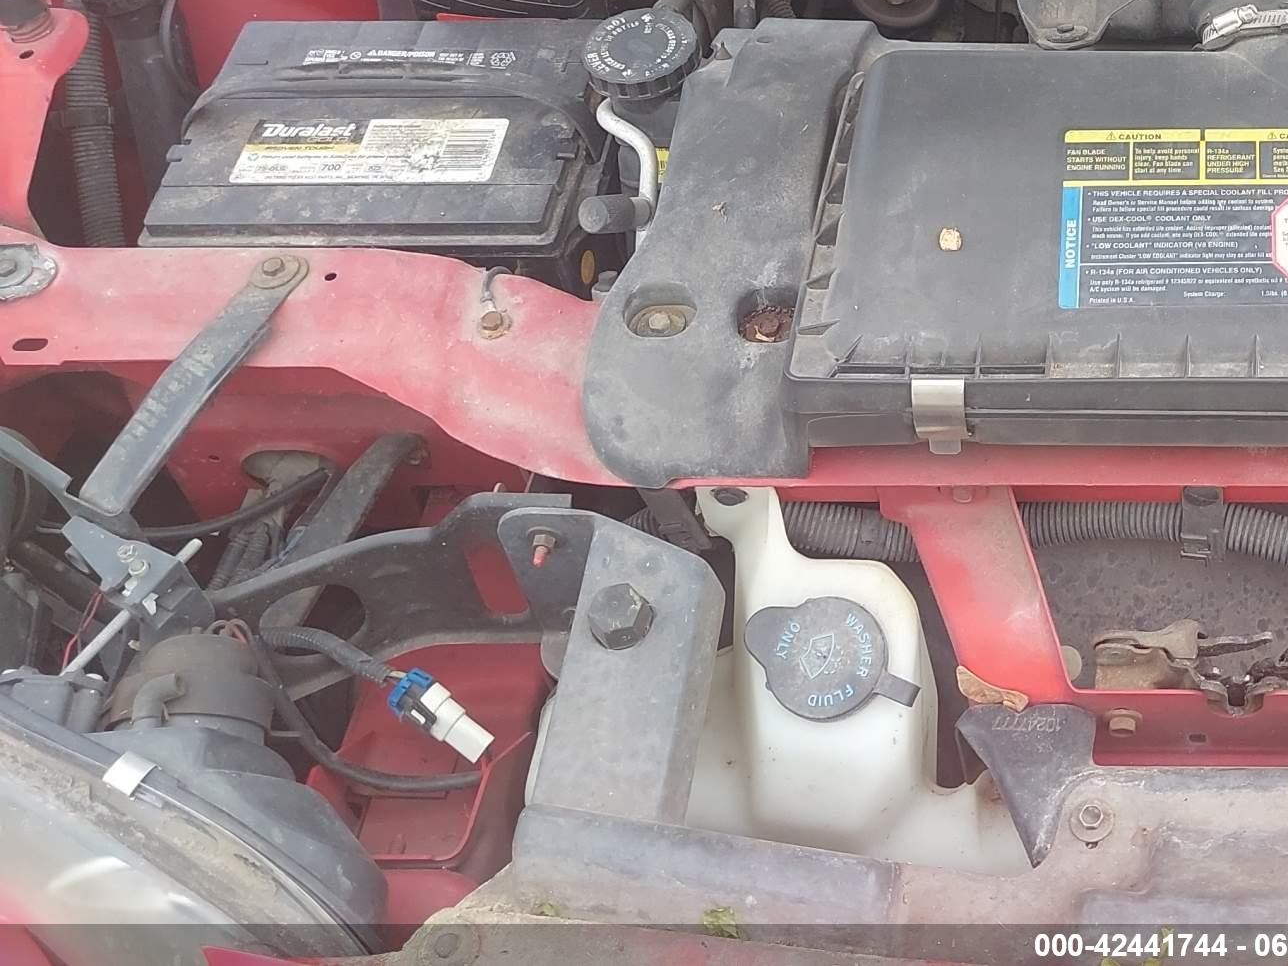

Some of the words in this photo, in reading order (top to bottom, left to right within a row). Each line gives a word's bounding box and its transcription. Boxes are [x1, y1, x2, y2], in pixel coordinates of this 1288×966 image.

[261, 123, 357, 138] Duralast
[320, 163, 341, 171] 700
[1065, 219, 1077, 269] NOTICE
[775, 620, 801, 659] ONLY
[845, 612, 873, 678] WASHER
[807, 683, 854, 707] FLUID
